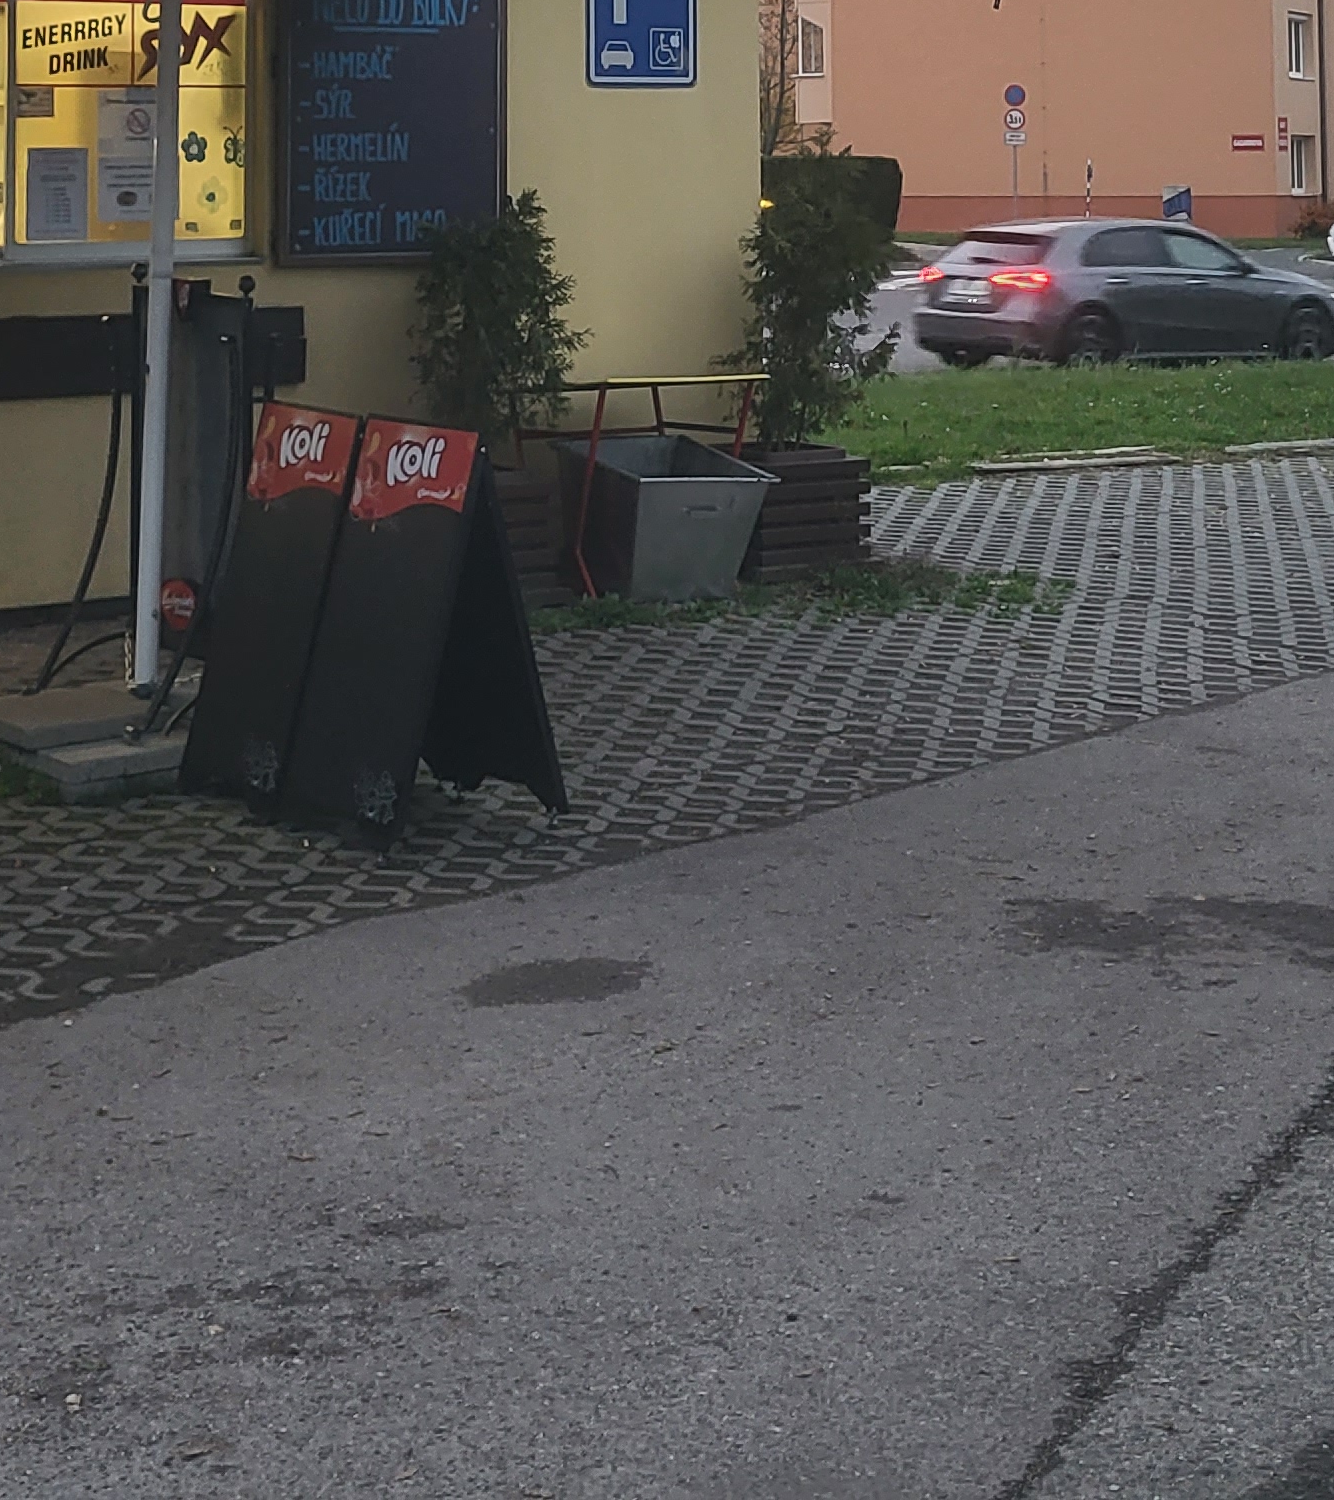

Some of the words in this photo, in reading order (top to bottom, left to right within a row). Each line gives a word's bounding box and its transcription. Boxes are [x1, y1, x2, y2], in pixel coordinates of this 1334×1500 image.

[21, 13, 127, 49] ENERRRGY
[48, 46, 109, 76] DRINK
[313, 83, 357, 120] SÝR
[312, 122, 410, 163] HERMELÍN
